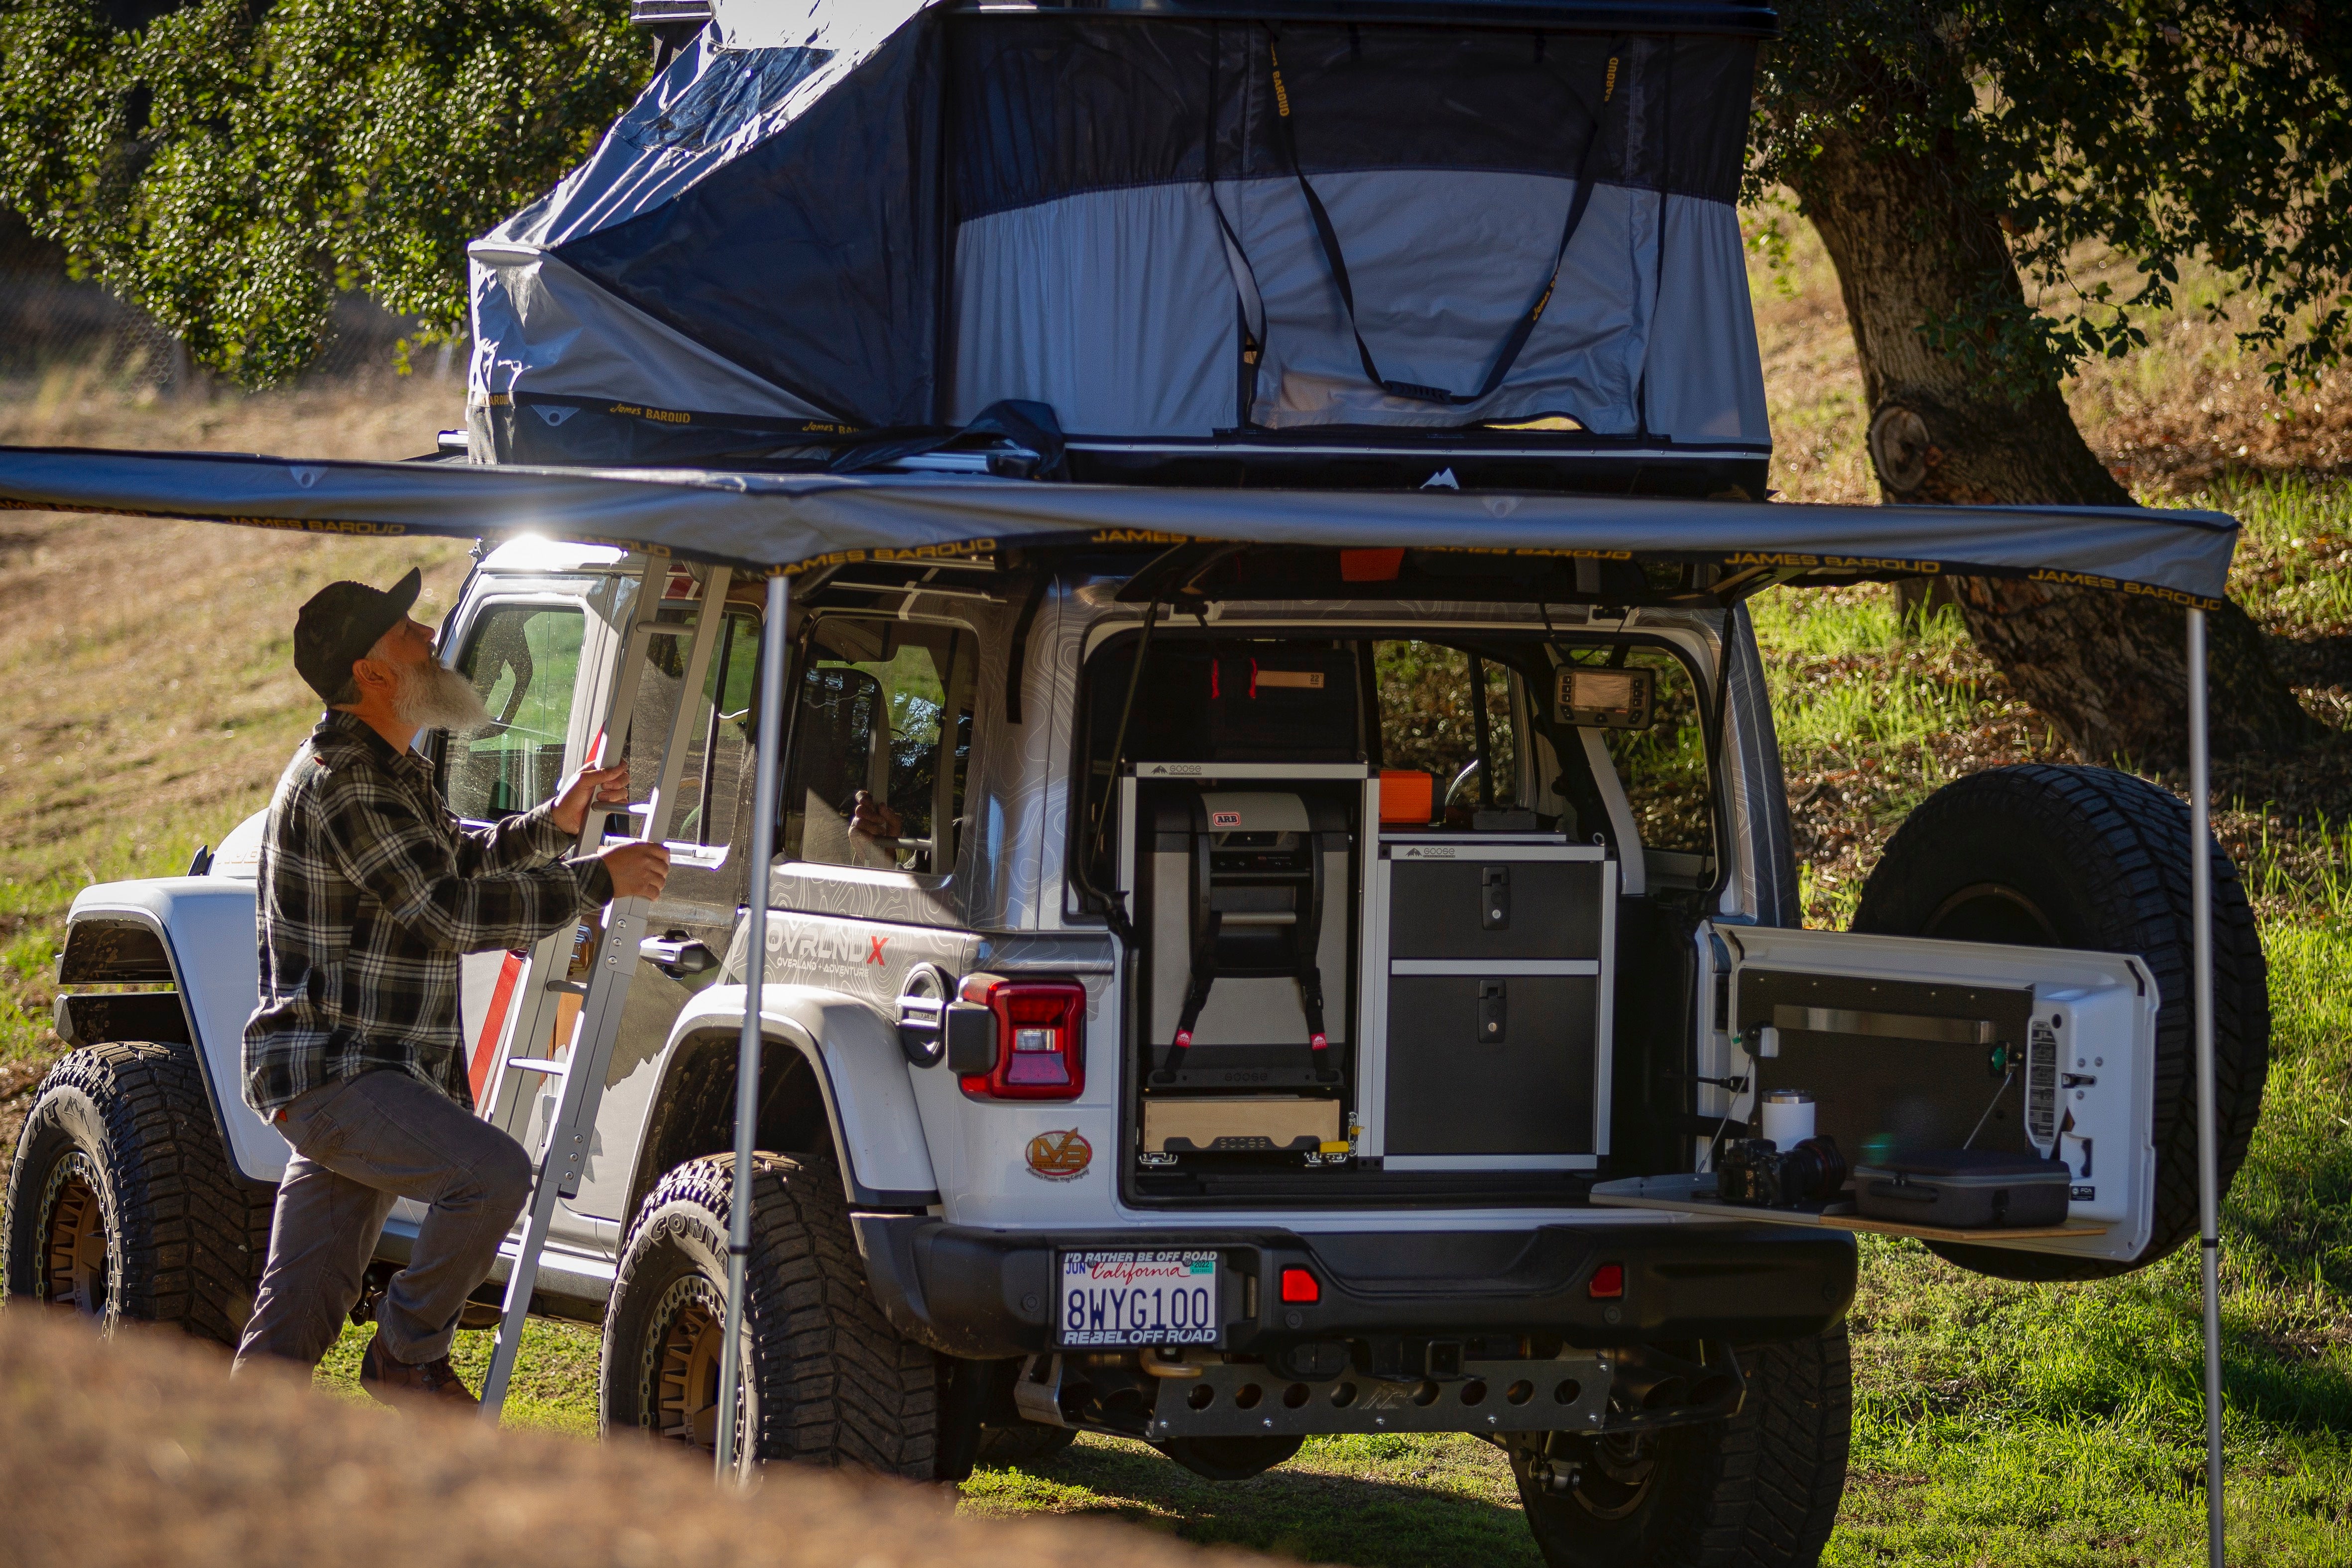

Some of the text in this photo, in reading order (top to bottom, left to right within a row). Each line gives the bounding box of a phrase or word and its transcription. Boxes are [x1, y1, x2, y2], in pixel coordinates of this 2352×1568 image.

[610, 404, 690, 423] James BAROUD
[802, 422, 833, 432] James
[227, 516, 405, 536] JAMES BAROUD
[1092, 529, 1188, 543] JAMES
[765, 537, 996, 577] JAMES BAROUD
[1516, 548, 1633, 560] BAROUD
[1724, 552, 1940, 573] JAMES BAROUD
[2028, 569, 2117, 590] JAMES
[777, 957, 817, 971] OVERLAND
[823, 963, 870, 978] ADVENTURE
[1084, 1251, 1134, 1263] RATHER
[1136, 1251, 1154, 1262] BE
[1156, 1251, 1181, 1262] OFF
[1182, 1251, 1217, 1262] ROAD
[1066, 1262, 1086, 1274] JUN
[1091, 1261, 1191, 1285] California
[1067, 1287, 1209, 1330] 8WYG100
[1063, 1329, 1217, 1344] REBEL OFF ROAD
